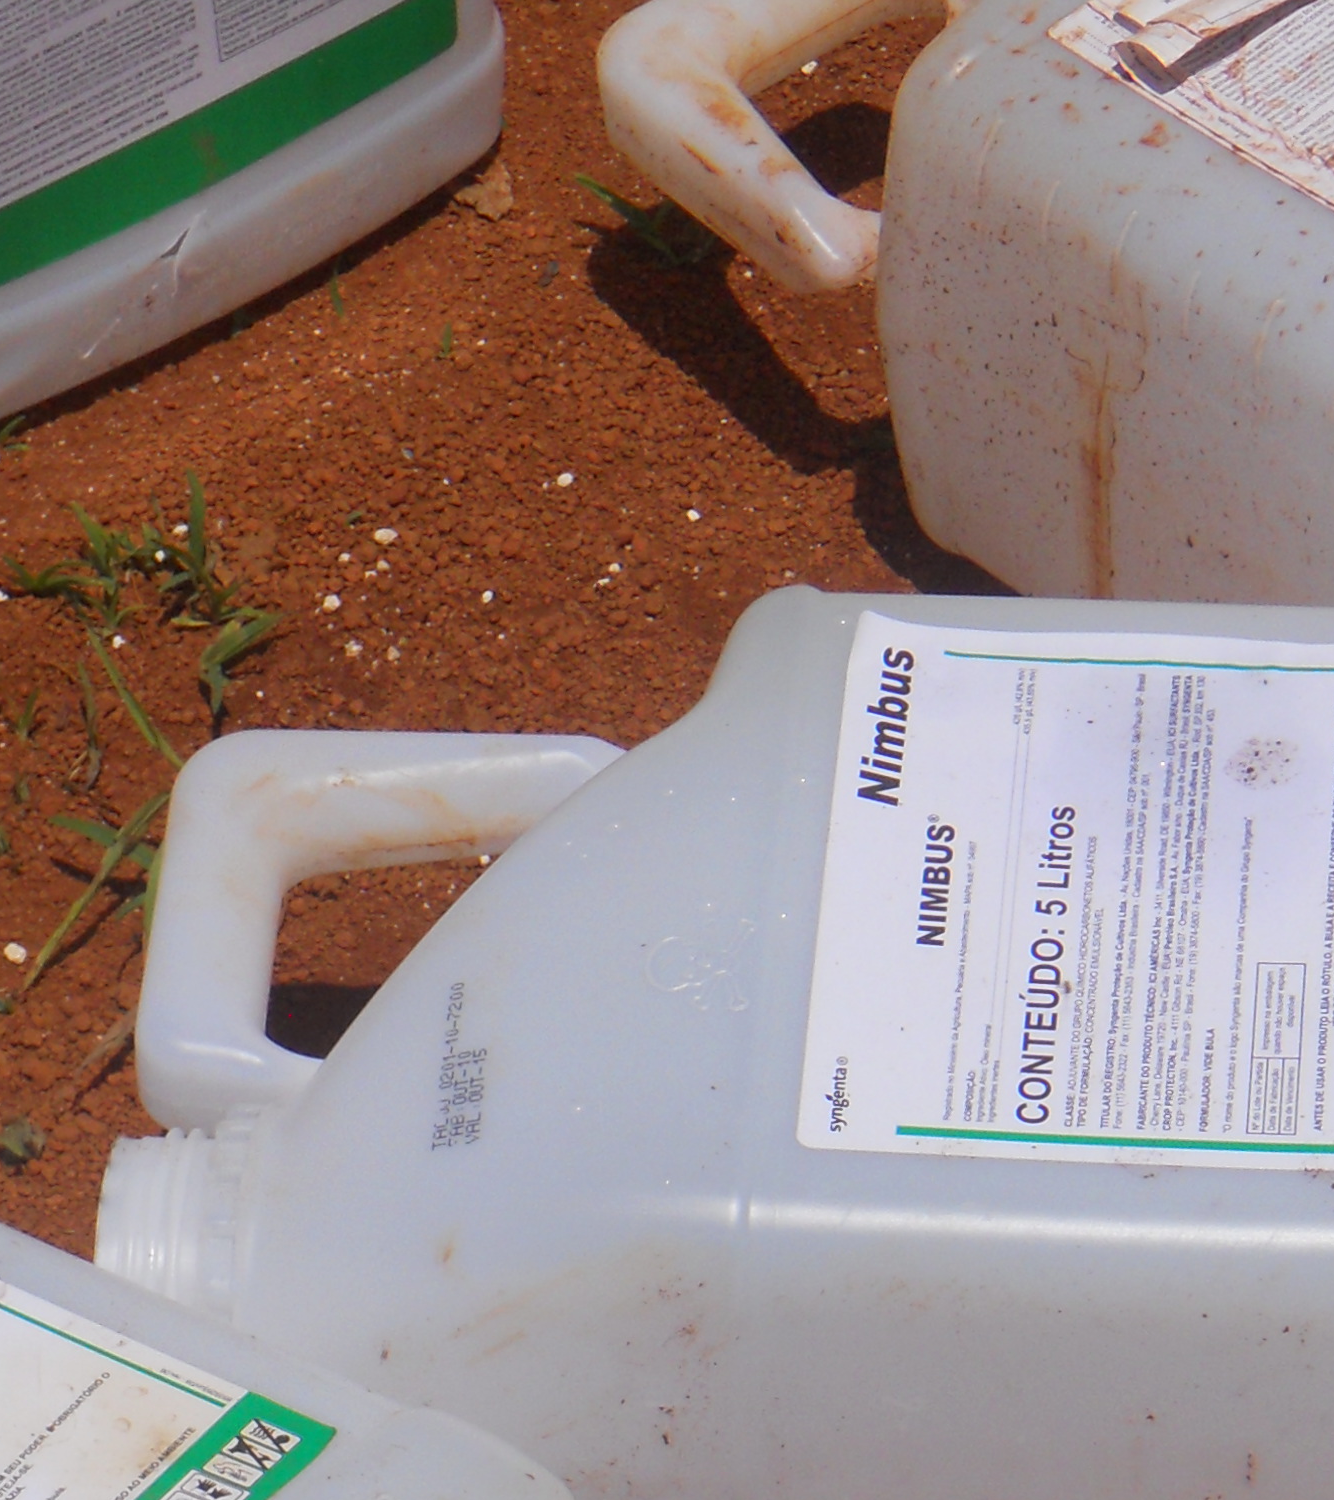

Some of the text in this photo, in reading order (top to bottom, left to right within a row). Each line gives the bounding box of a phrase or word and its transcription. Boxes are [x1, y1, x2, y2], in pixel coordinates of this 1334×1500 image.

[856, 649, 915, 806] Nimbus
[1012, 806, 1076, 1125] CONTEÚDO: 5 Litros
